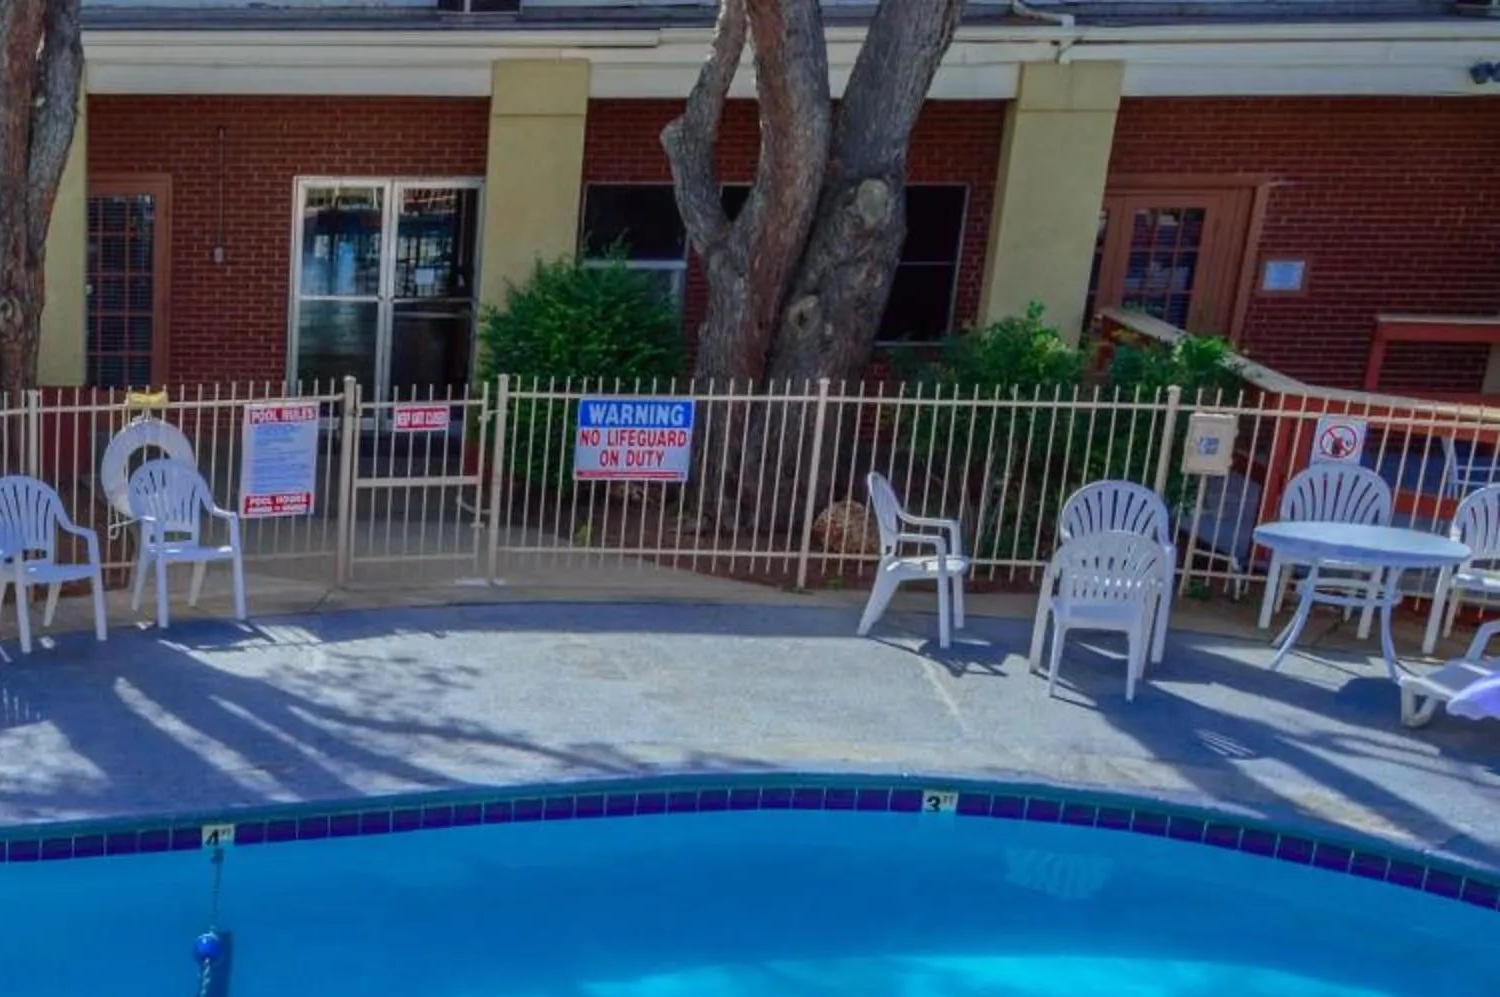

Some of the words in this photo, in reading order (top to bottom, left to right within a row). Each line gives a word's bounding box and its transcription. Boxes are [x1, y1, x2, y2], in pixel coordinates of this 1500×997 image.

[588, 403, 684, 426] WARNING
[580, 429, 599, 447] NO
[607, 429, 686, 447] LIFEGUARD
[600, 450, 619, 467] ON
[626, 450, 665, 467] DUTY
